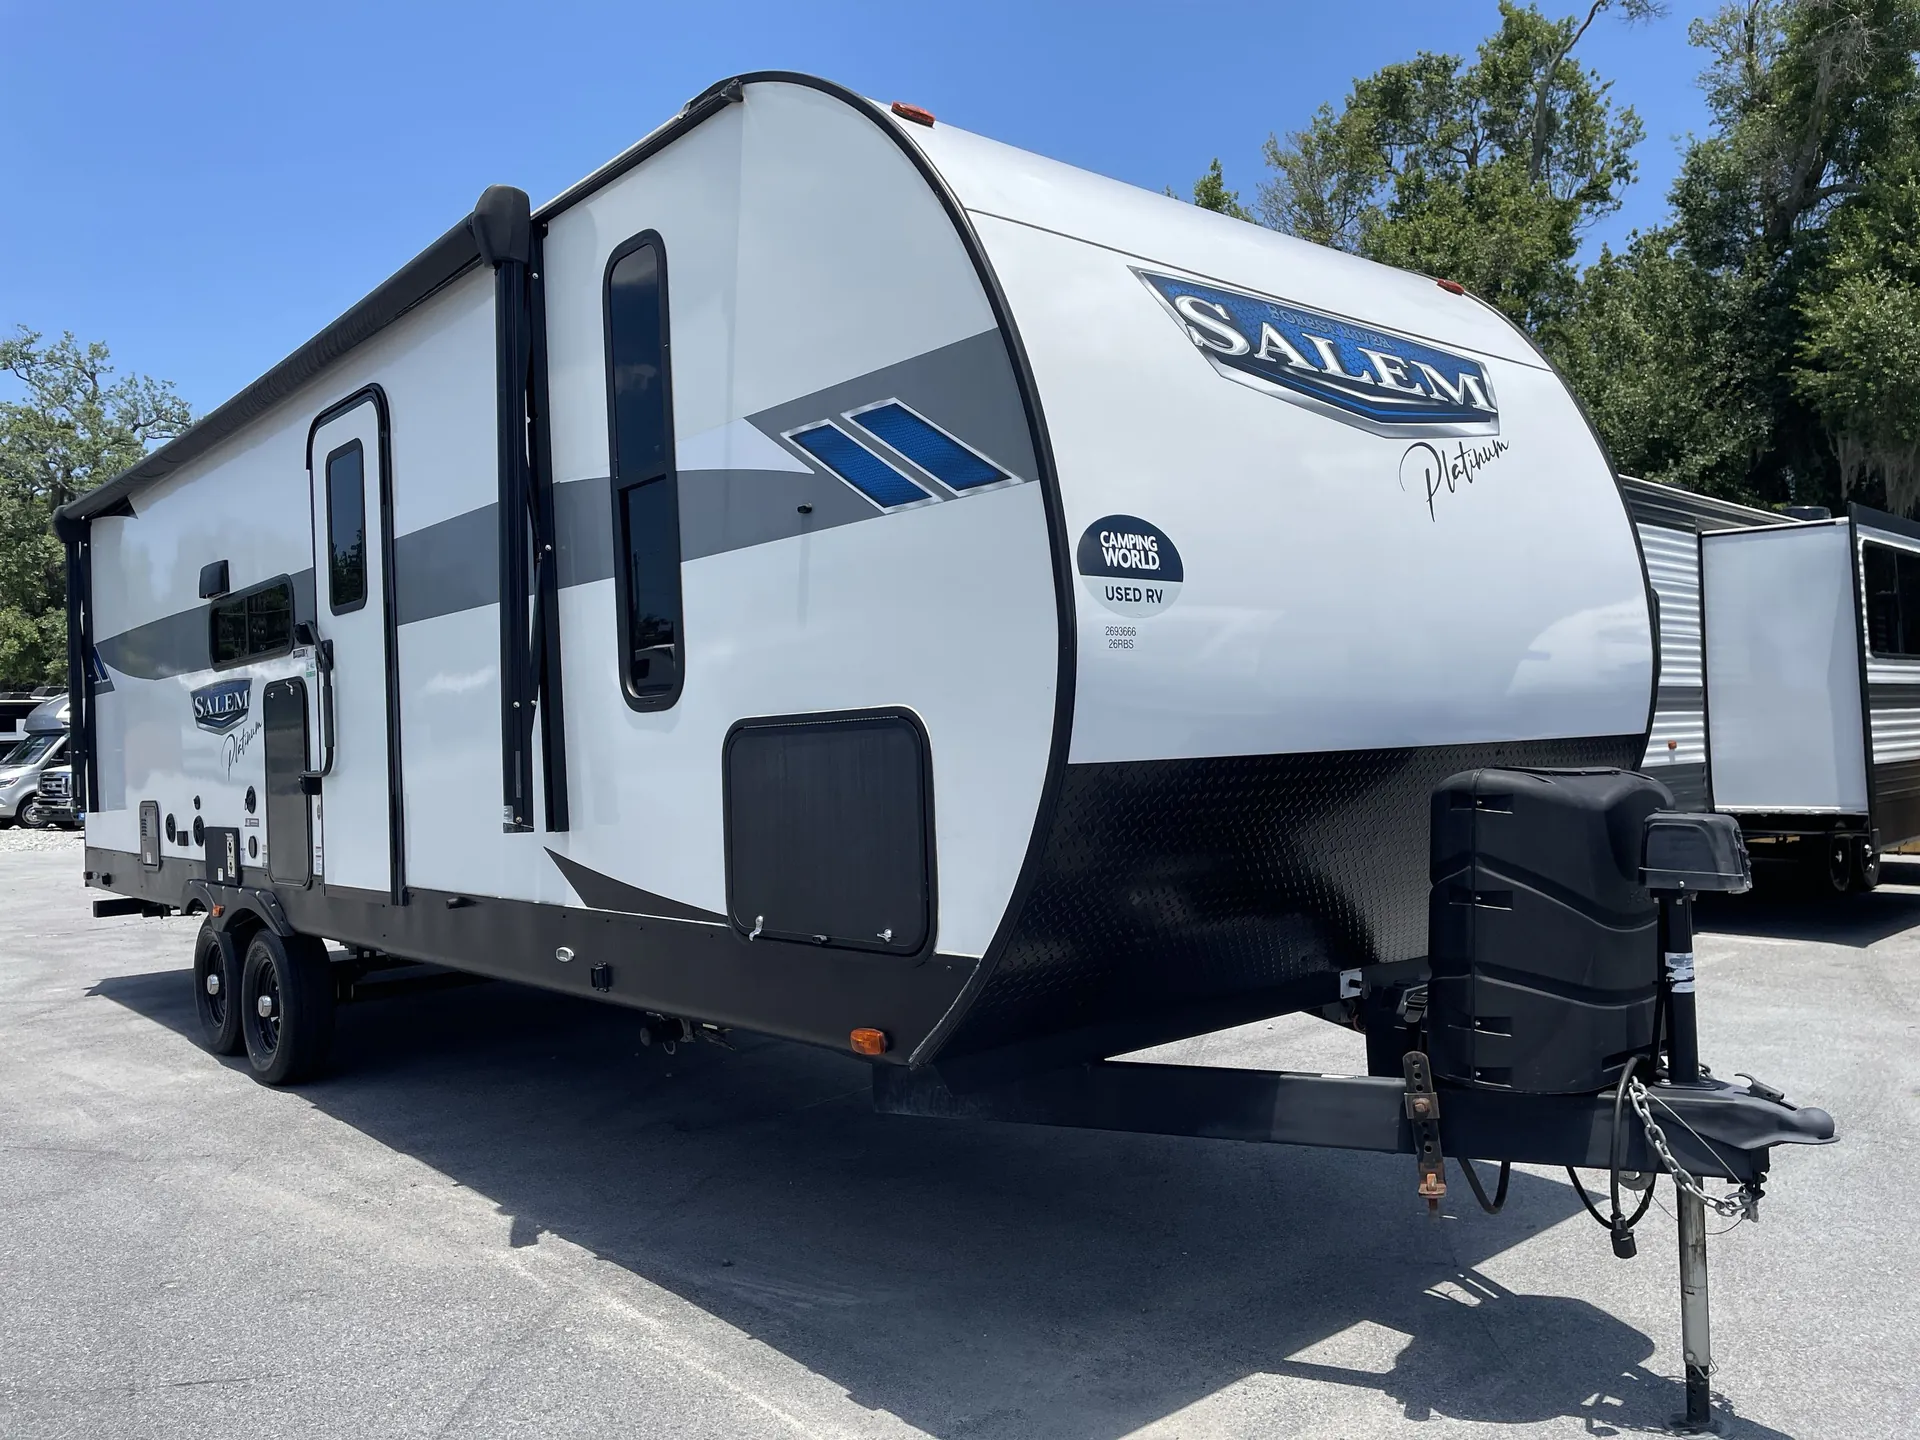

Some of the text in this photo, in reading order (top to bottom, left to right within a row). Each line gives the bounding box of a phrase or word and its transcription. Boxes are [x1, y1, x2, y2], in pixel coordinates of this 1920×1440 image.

[1263, 302, 1395, 350] FOREST RIVER
[1174, 294, 1498, 414] SALEM
[1399, 439, 1509, 522] Platinum
[1100, 531, 1158, 551] CAMPING
[1105, 585, 1163, 604] USED RV
[1105, 625, 1136, 637] 2693666
[1108, 638, 1134, 649] 26RBS
[194, 689, 249, 718] SALEM
[220, 721, 262, 782] Platinum
